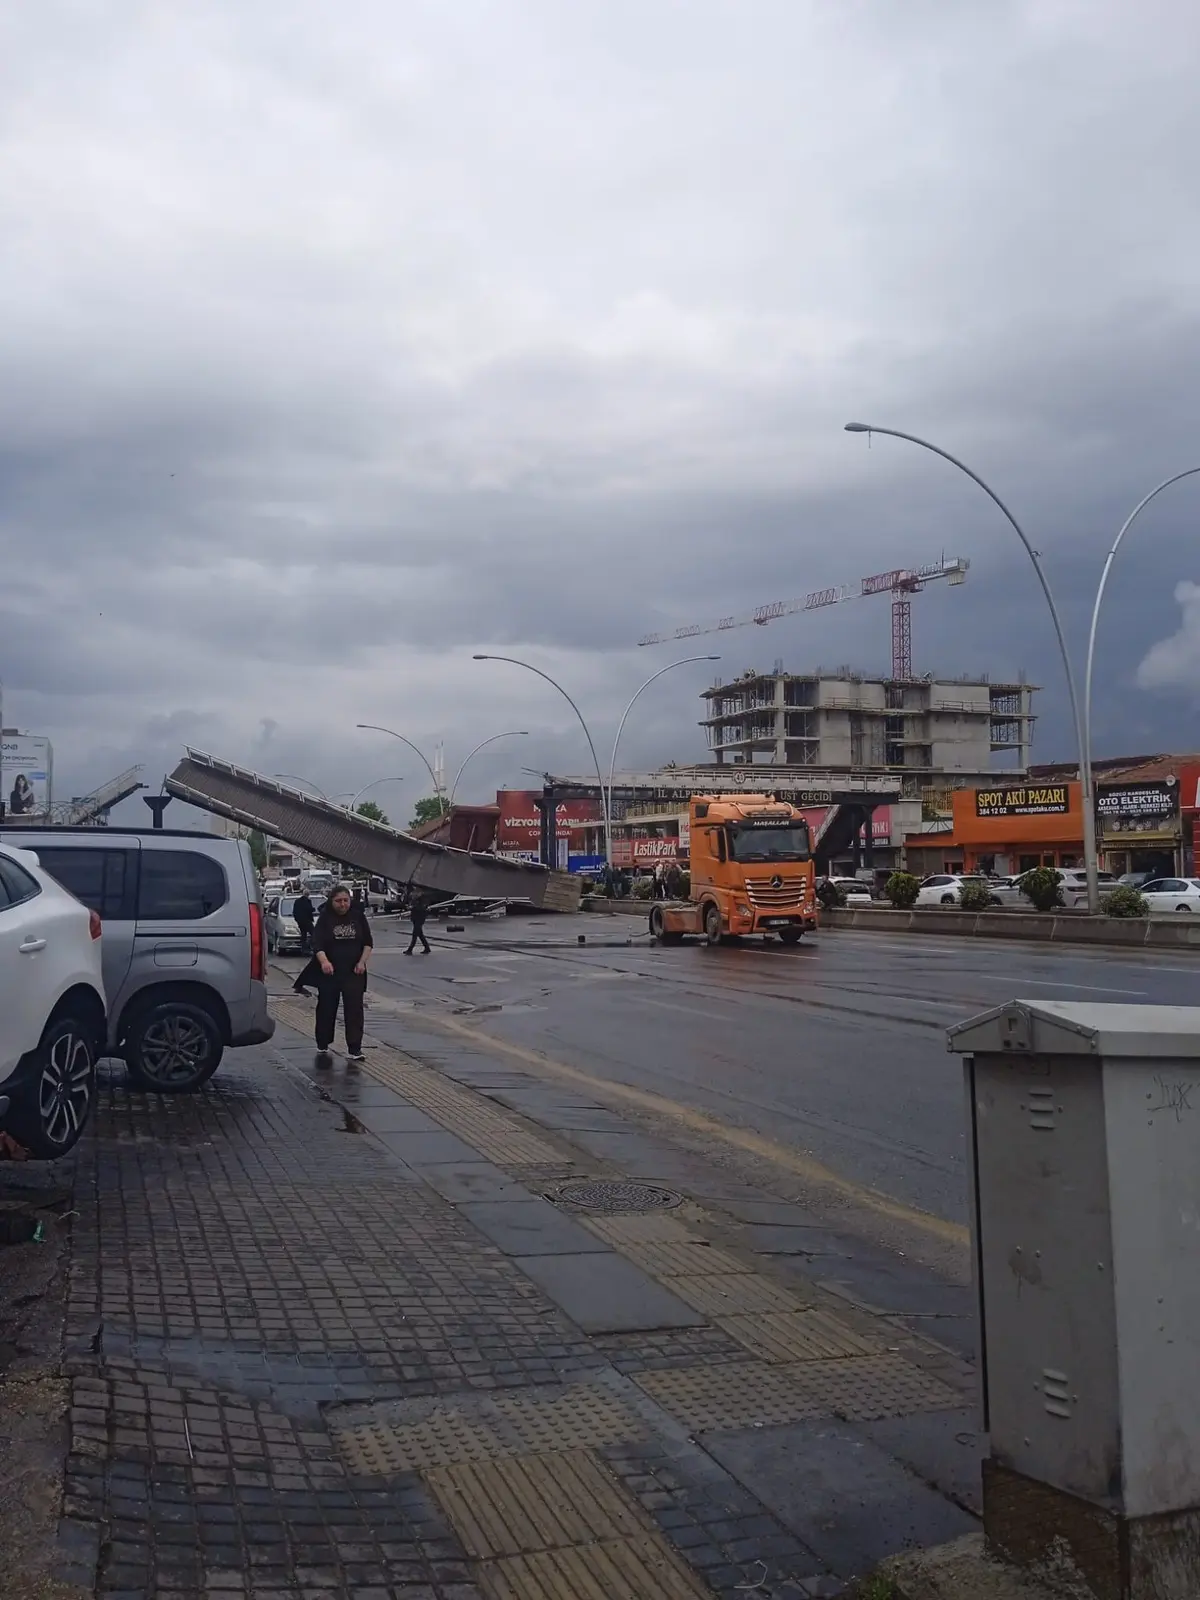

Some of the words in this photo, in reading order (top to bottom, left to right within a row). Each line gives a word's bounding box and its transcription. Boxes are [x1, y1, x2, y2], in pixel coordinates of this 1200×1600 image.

[978, 793, 1003, 807] SPOT
[1005, 789, 1025, 806] AKÜ
[1028, 788, 1065, 804] PAZARI
[1098, 797, 1119, 806] OTO
[1121, 793, 1172, 805] ELEKTRİK
[979, 807, 990, 815] 384
[991, 807, 998, 815] 12
[999, 806, 1007, 814] 02
[1015, 805, 1065, 814] www.spotaku.com.tr
[634, 840, 677, 856] LastikPark
